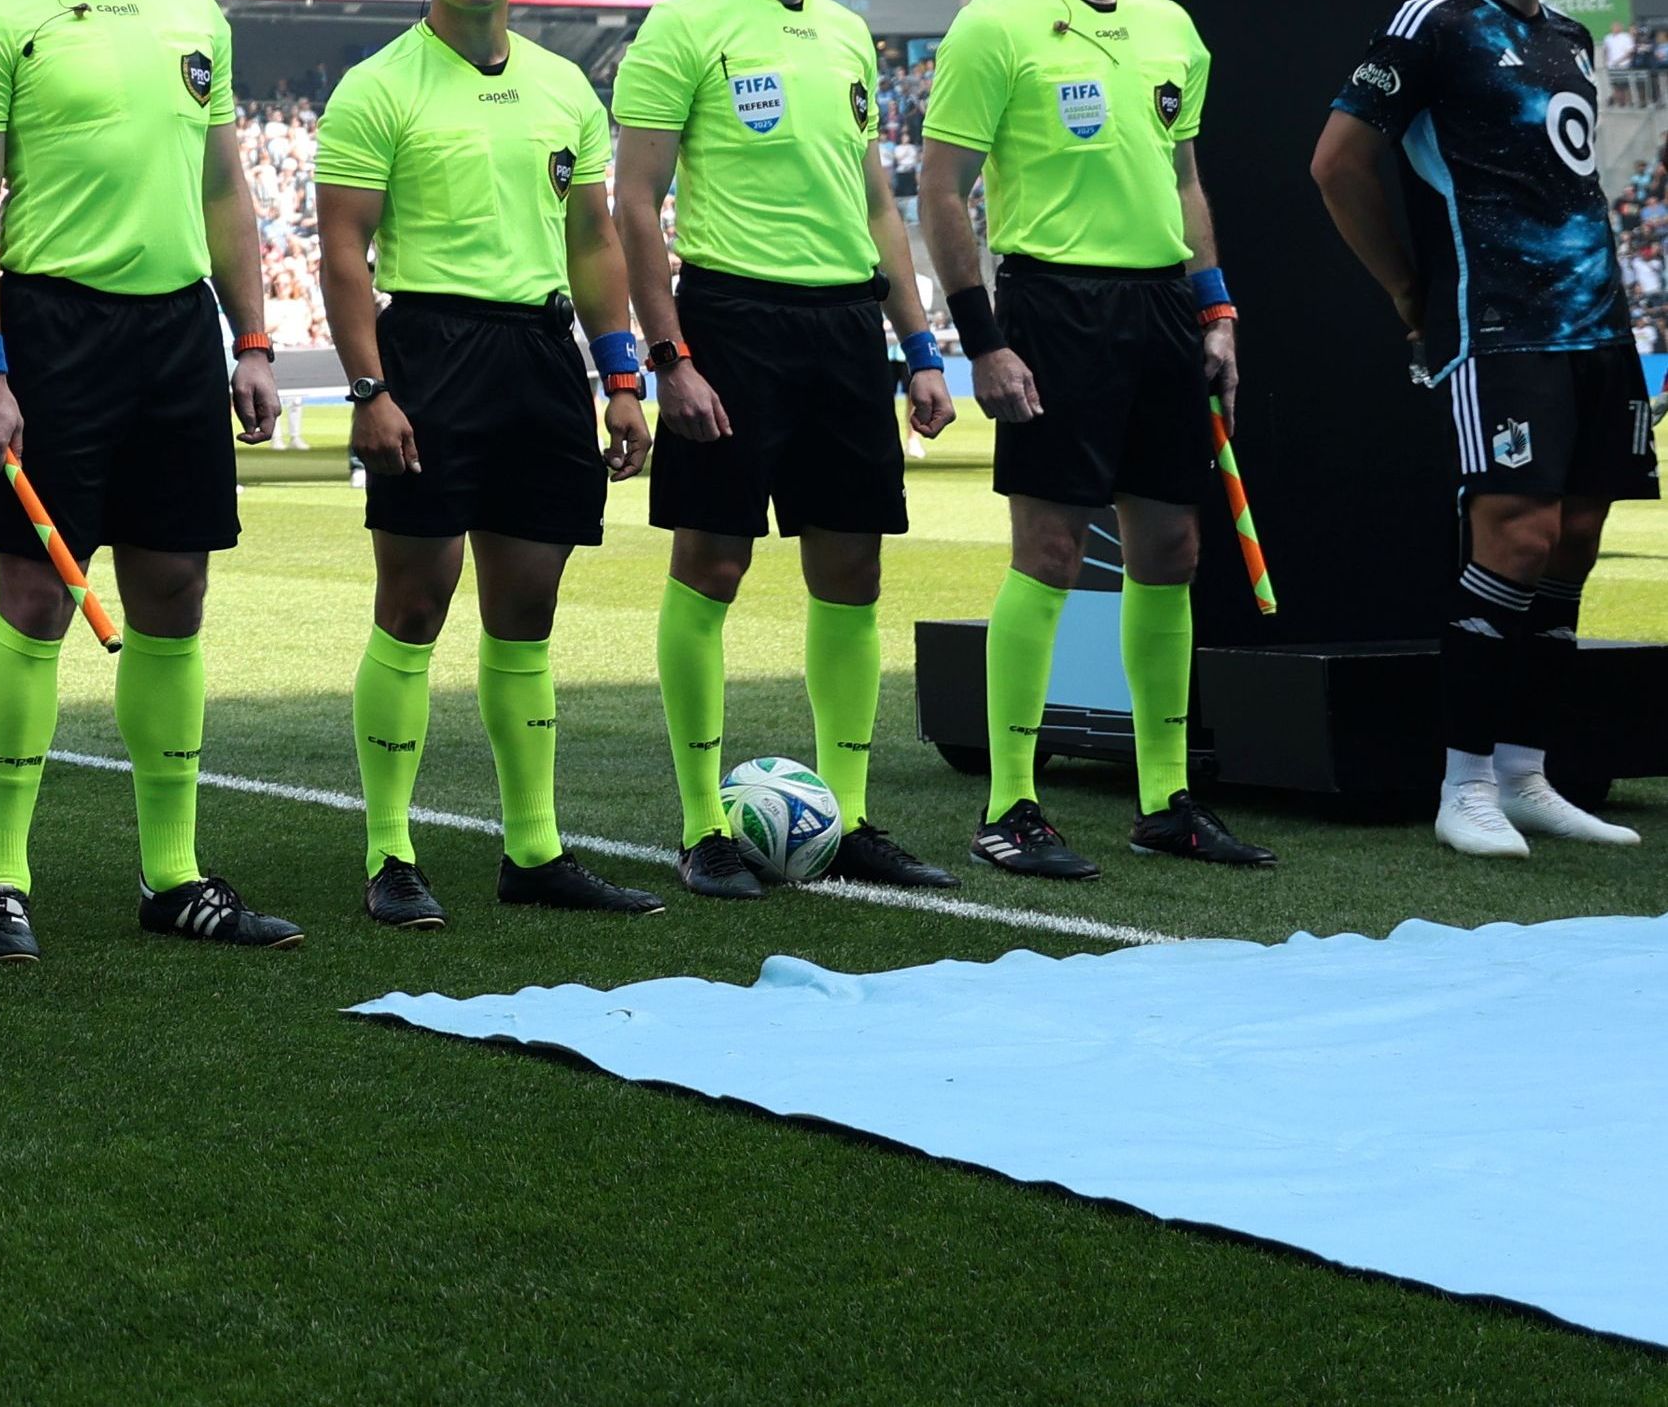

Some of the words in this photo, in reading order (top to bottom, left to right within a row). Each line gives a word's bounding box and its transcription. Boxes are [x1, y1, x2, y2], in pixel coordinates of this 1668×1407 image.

[190, 67, 211, 83] PRO
[734, 75, 778, 95] FIFA
[1061, 84, 1100, 101] FIFA
[478, 88, 520, 104] capelli
[1161, 96, 1178, 108] PRO
[738, 98, 781, 112] REFEREE
[1064, 104, 1102, 113] ASSISTANT
[556, 164, 572, 178] PRO
